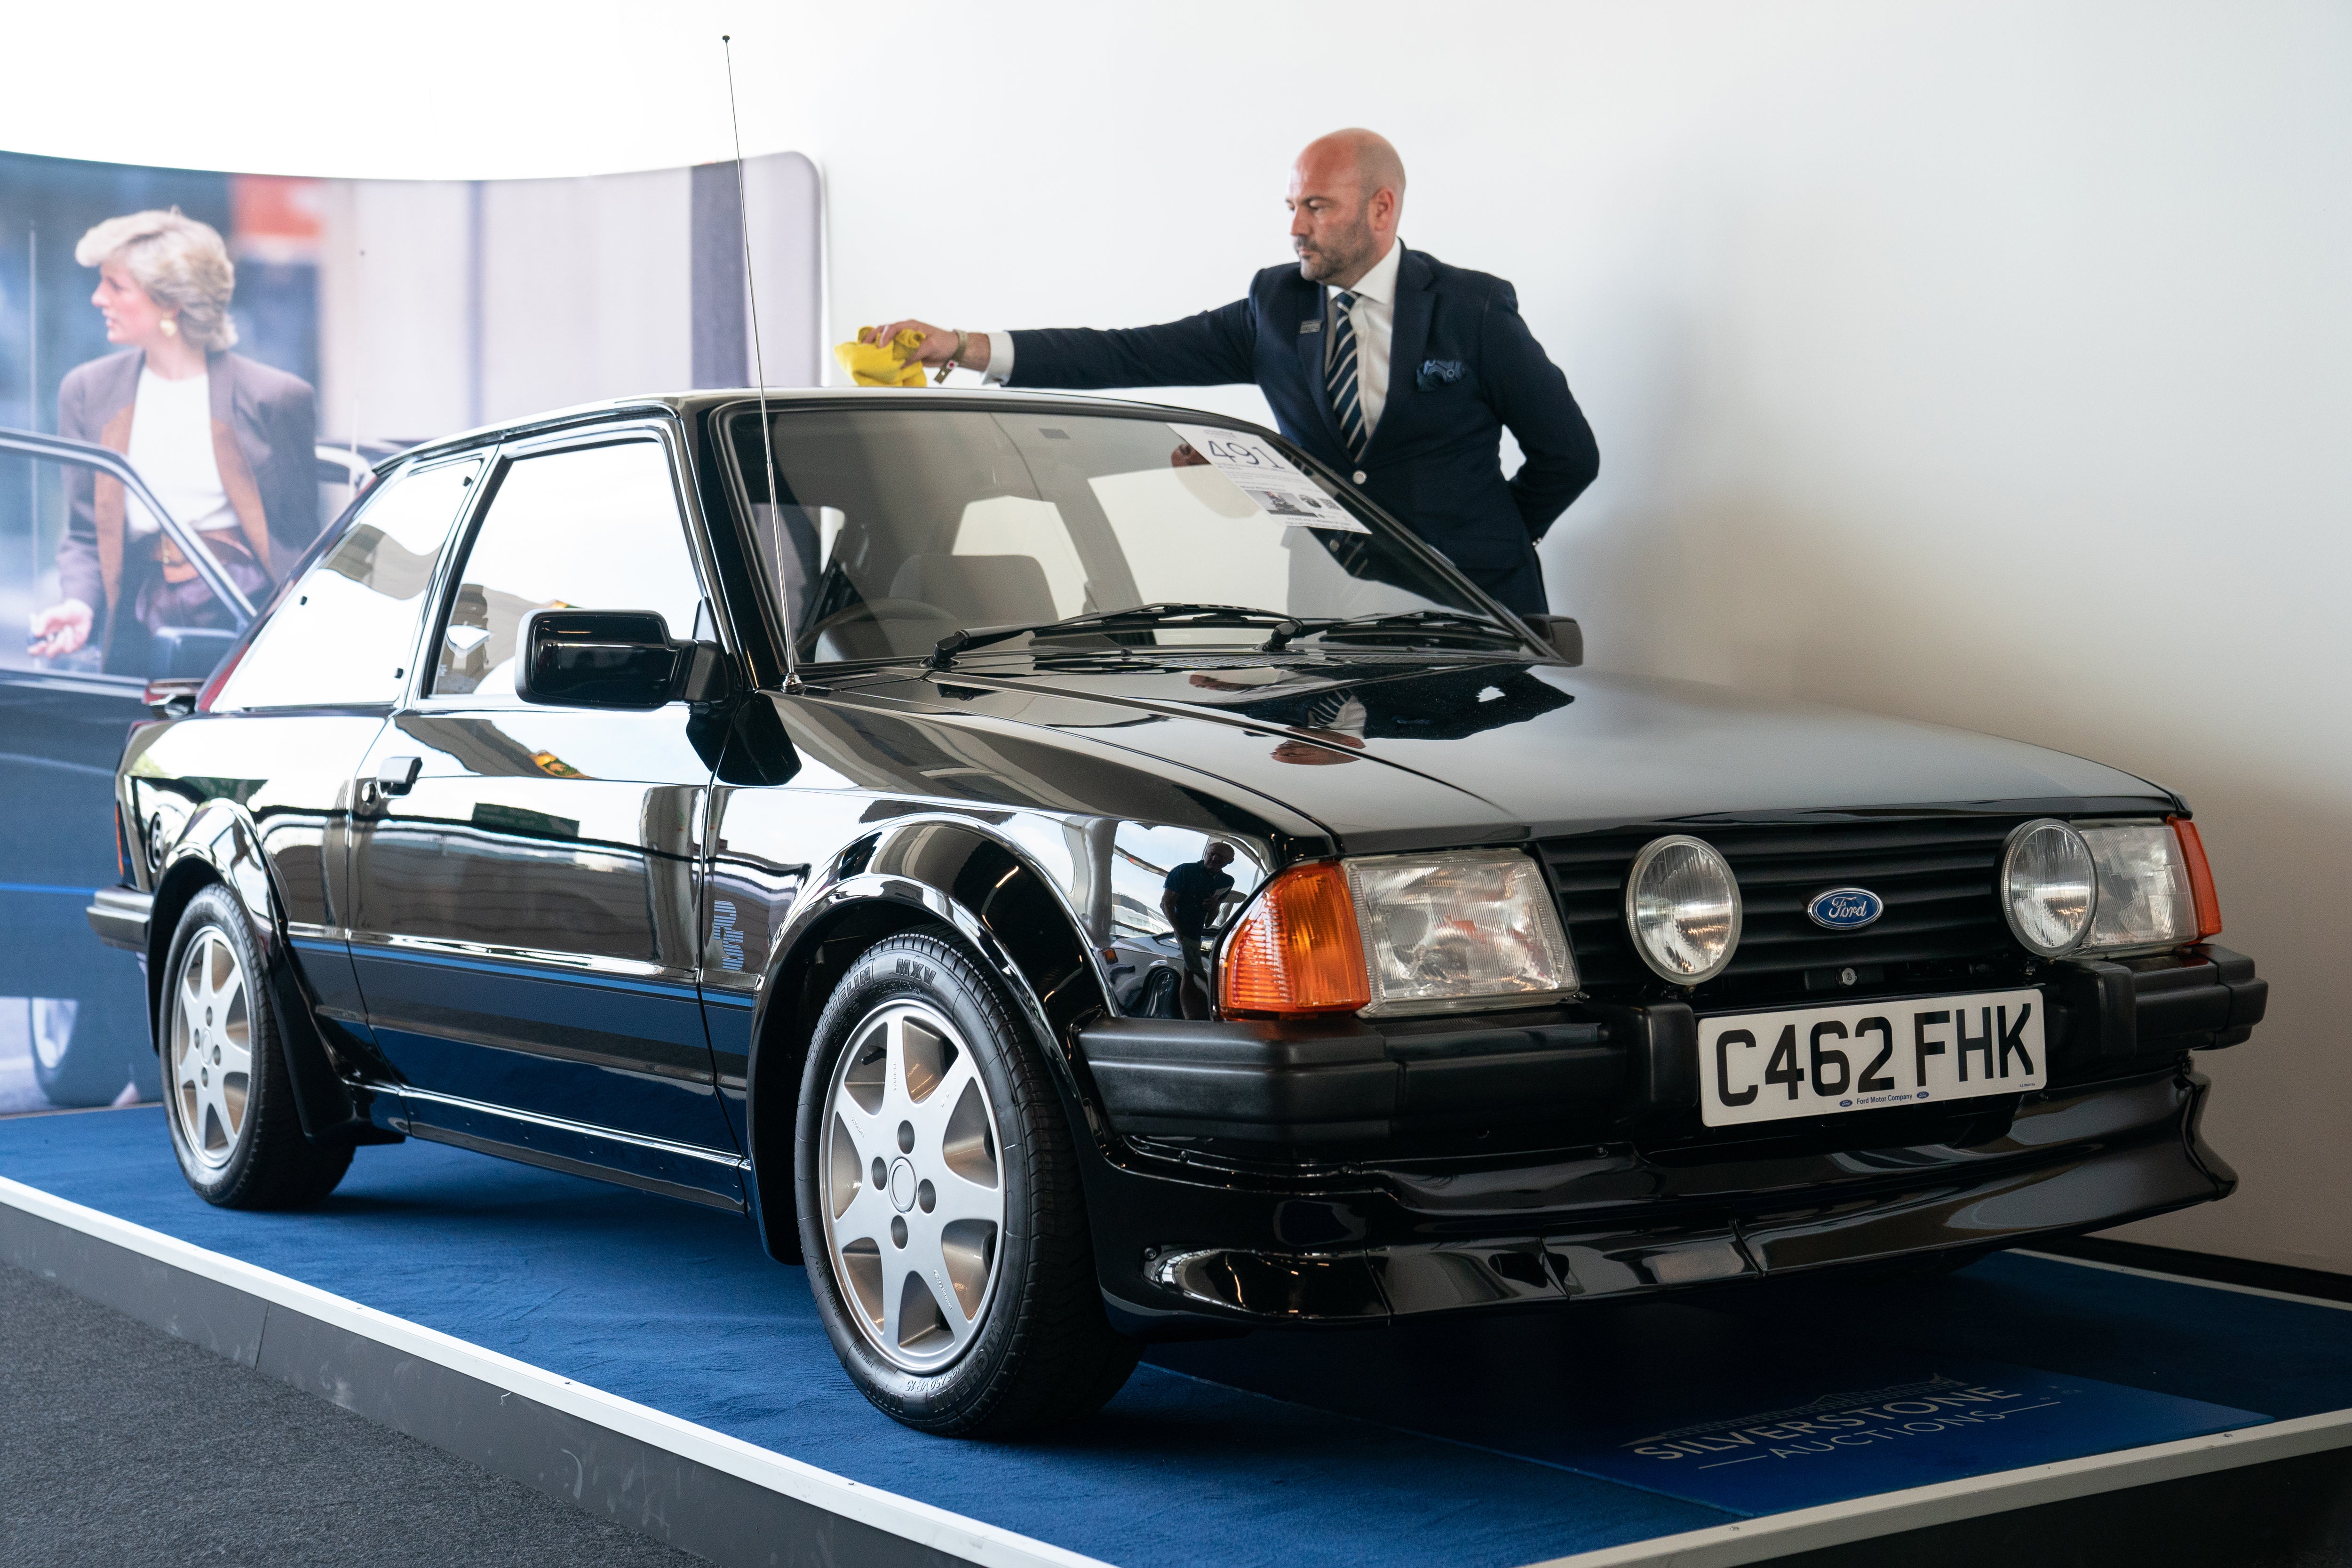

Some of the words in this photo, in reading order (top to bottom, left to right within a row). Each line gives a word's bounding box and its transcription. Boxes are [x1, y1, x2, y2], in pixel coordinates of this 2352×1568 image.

[1208, 440, 1285, 470] 491
[1828, 896, 1867, 918] Ford
[896, 958, 937, 987] MXV
[809, 965, 871, 1067] MICHELIN
[1716, 1016, 1895, 1107] C462
[1914, 1003, 2034, 1087] FHK
[853, 1342, 874, 1368] TUBELESS
[930, 1317, 1005, 1413] MICHELIN
[866, 1379, 904, 1413] MXV
[1633, 1386, 2023, 1460] SILVERSTONE
[1769, 1409, 2006, 1459] AUCTIONS
